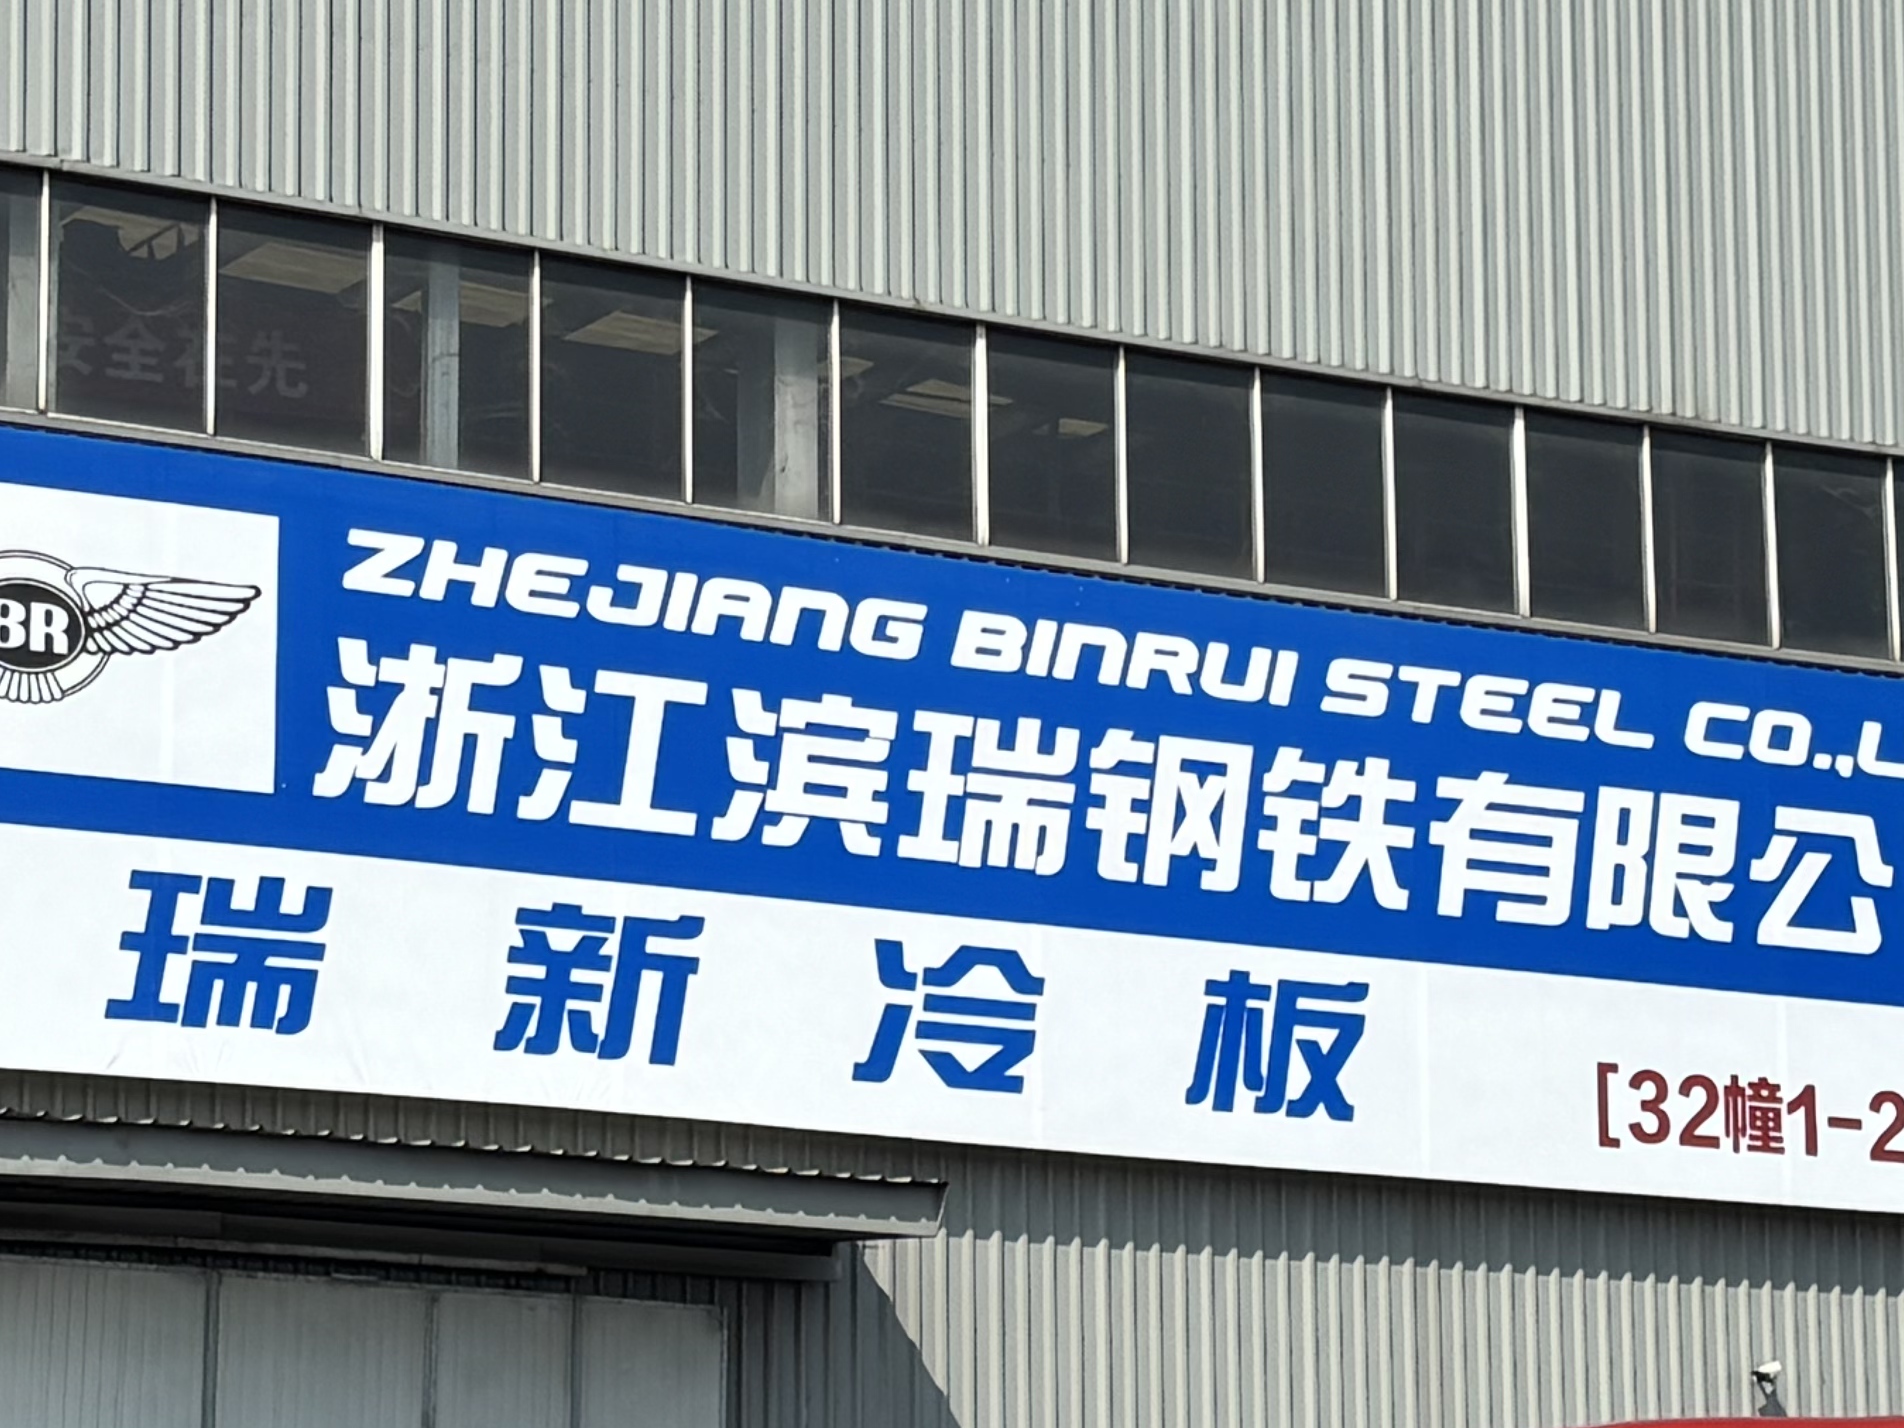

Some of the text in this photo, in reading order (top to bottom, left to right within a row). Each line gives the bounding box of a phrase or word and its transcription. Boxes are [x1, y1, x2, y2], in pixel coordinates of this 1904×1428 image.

[343, 529, 927, 659] ZHEJIANG
[951, 611, 1298, 706] BINRUI
[1321, 659, 1654, 748] STEEL
[105, 870, 1369, 1122] 瑞新冷板
